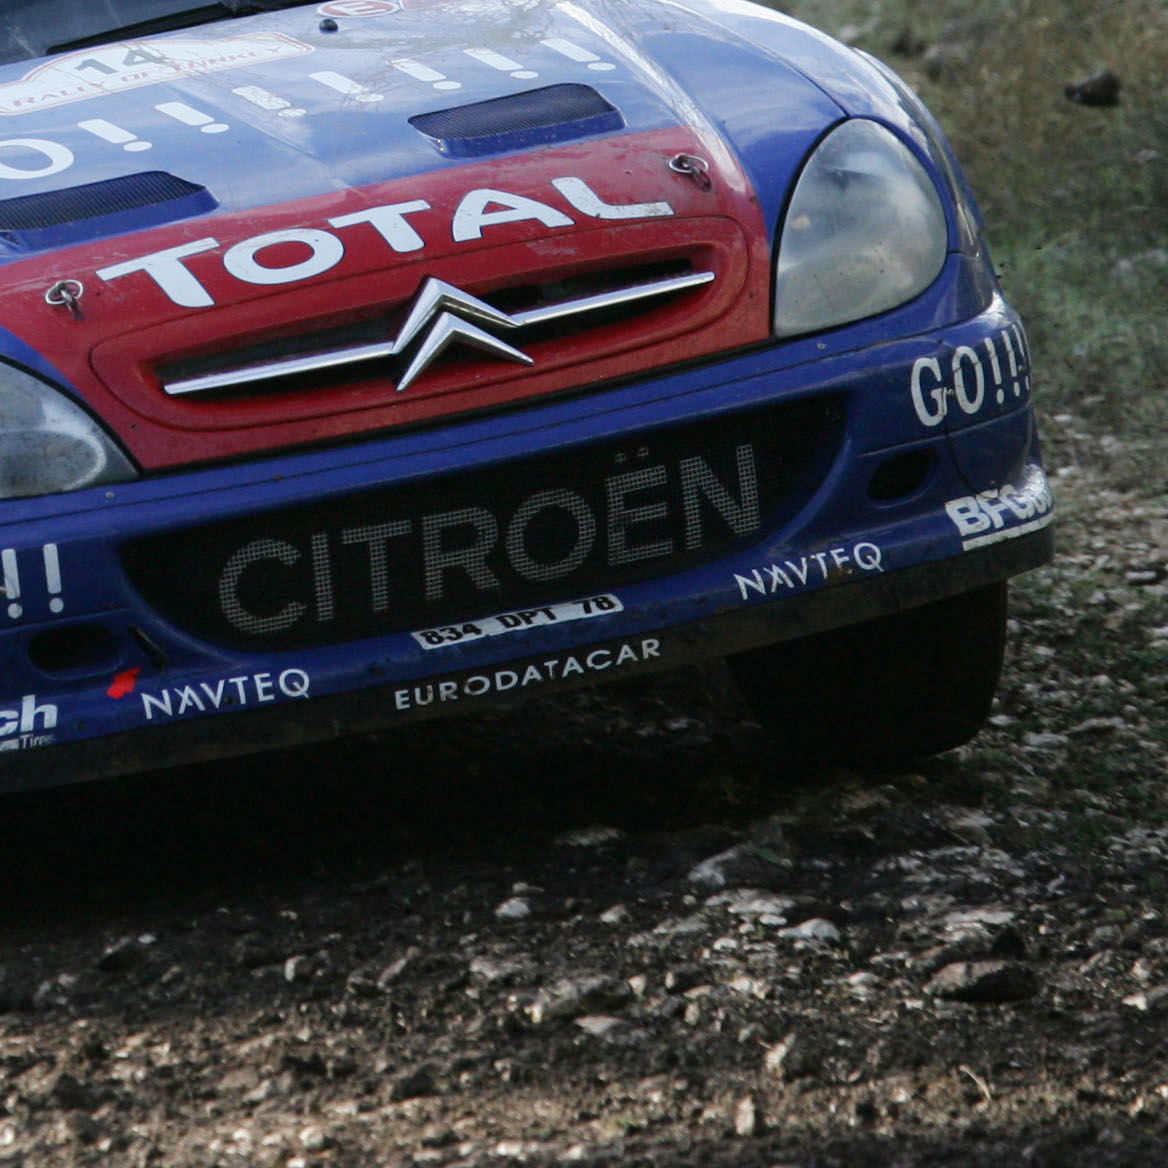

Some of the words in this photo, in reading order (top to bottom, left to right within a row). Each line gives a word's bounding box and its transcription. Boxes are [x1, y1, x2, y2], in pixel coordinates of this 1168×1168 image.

[74, 45, 169, 75] 14
[13, 82, 105, 107] RALLY
[98, 175, 674, 309] TOTAL
[218, 443, 761, 635] CITROËN
[733, 541, 885, 601] NAVTEQ
[420, 622, 484, 647] 834
[495, 606, 559, 630] DPT
[577, 596, 617, 615] 78
[140, 668, 311, 720] NAVTEQ
[394, 638, 661, 711] EURODATACAR
